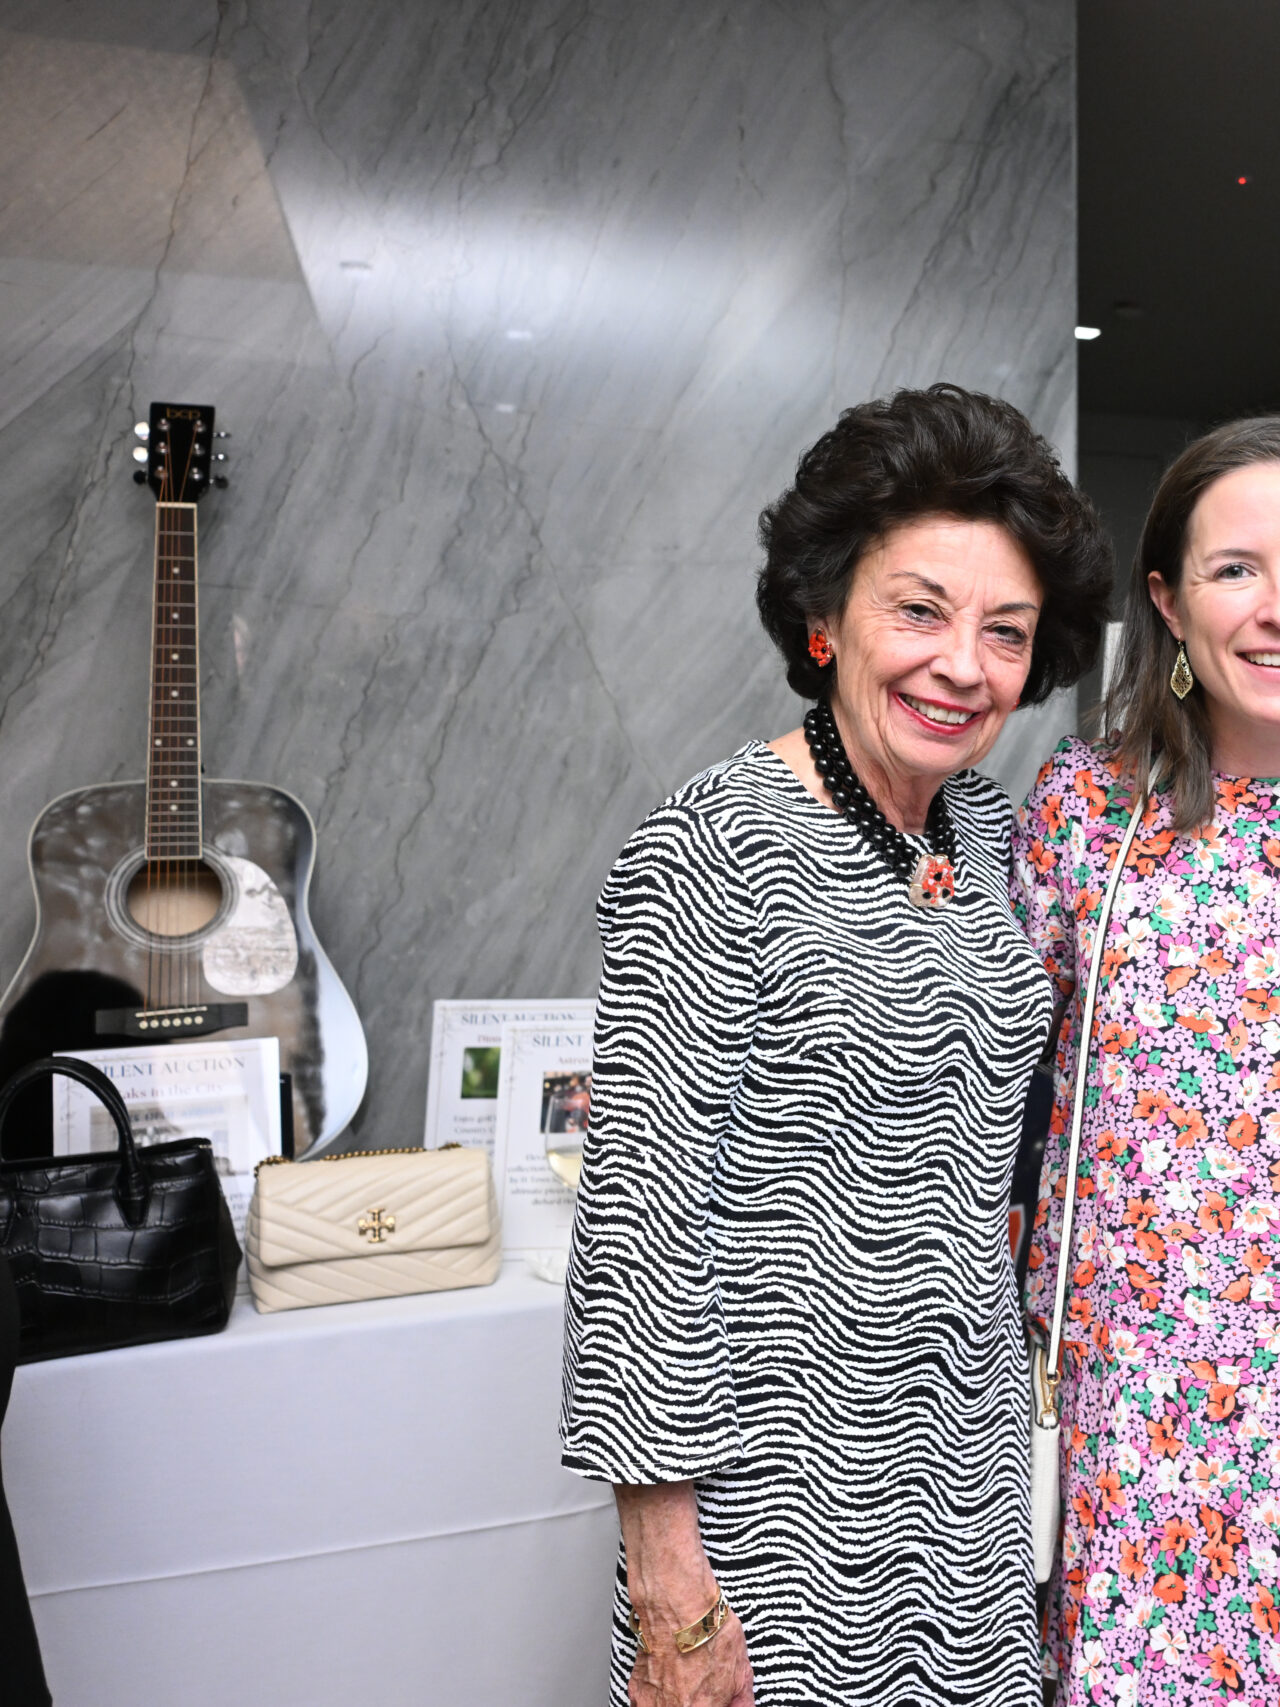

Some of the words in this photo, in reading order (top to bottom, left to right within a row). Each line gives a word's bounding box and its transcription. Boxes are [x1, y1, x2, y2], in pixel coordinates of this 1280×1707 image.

[461, 1012, 508, 1025] SILENT
[532, 1034, 584, 1048] SILENT
[101, 1063, 154, 1079] ILENT
[160, 1056, 246, 1074] AUCTION
[166, 1082, 193, 1096] the
[194, 1081, 224, 1097] City
